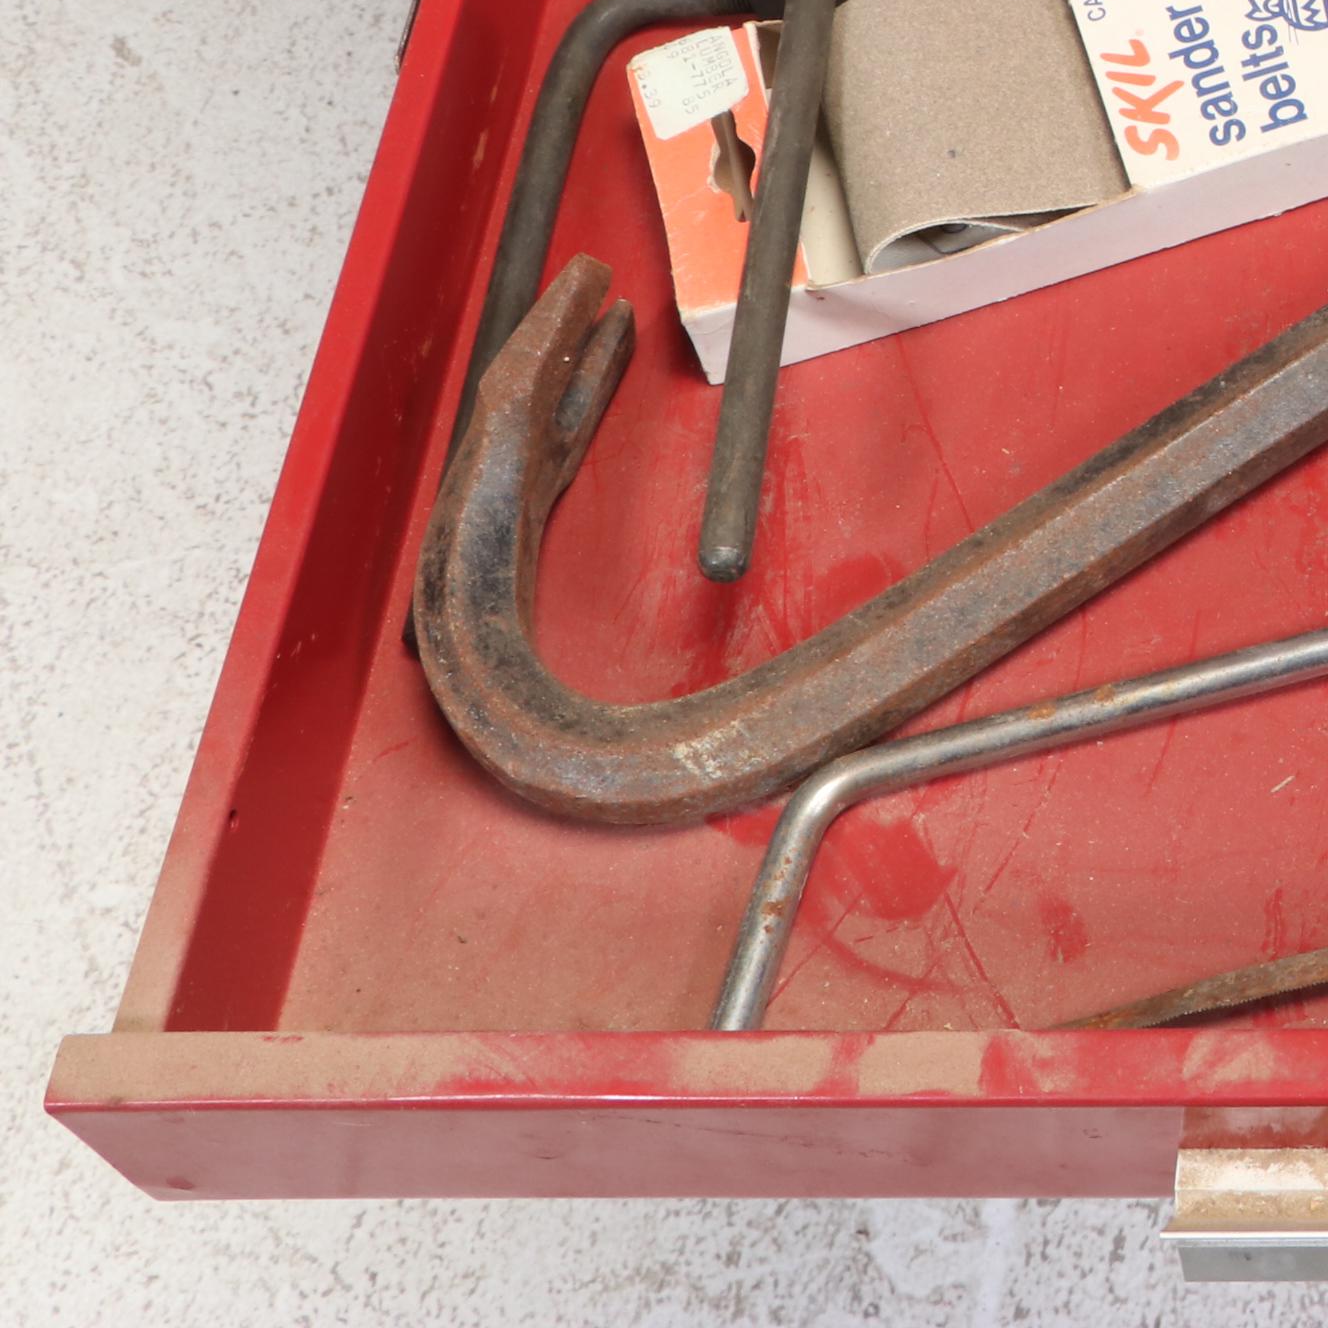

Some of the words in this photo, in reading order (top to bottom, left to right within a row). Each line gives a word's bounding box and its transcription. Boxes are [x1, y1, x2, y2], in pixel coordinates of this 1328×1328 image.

[696, 40, 723, 93] LUMBER
[1099, 38, 1185, 161] SKIL
[1165, 4, 1247, 147] sander
[1240, 23, 1308, 133] belts
